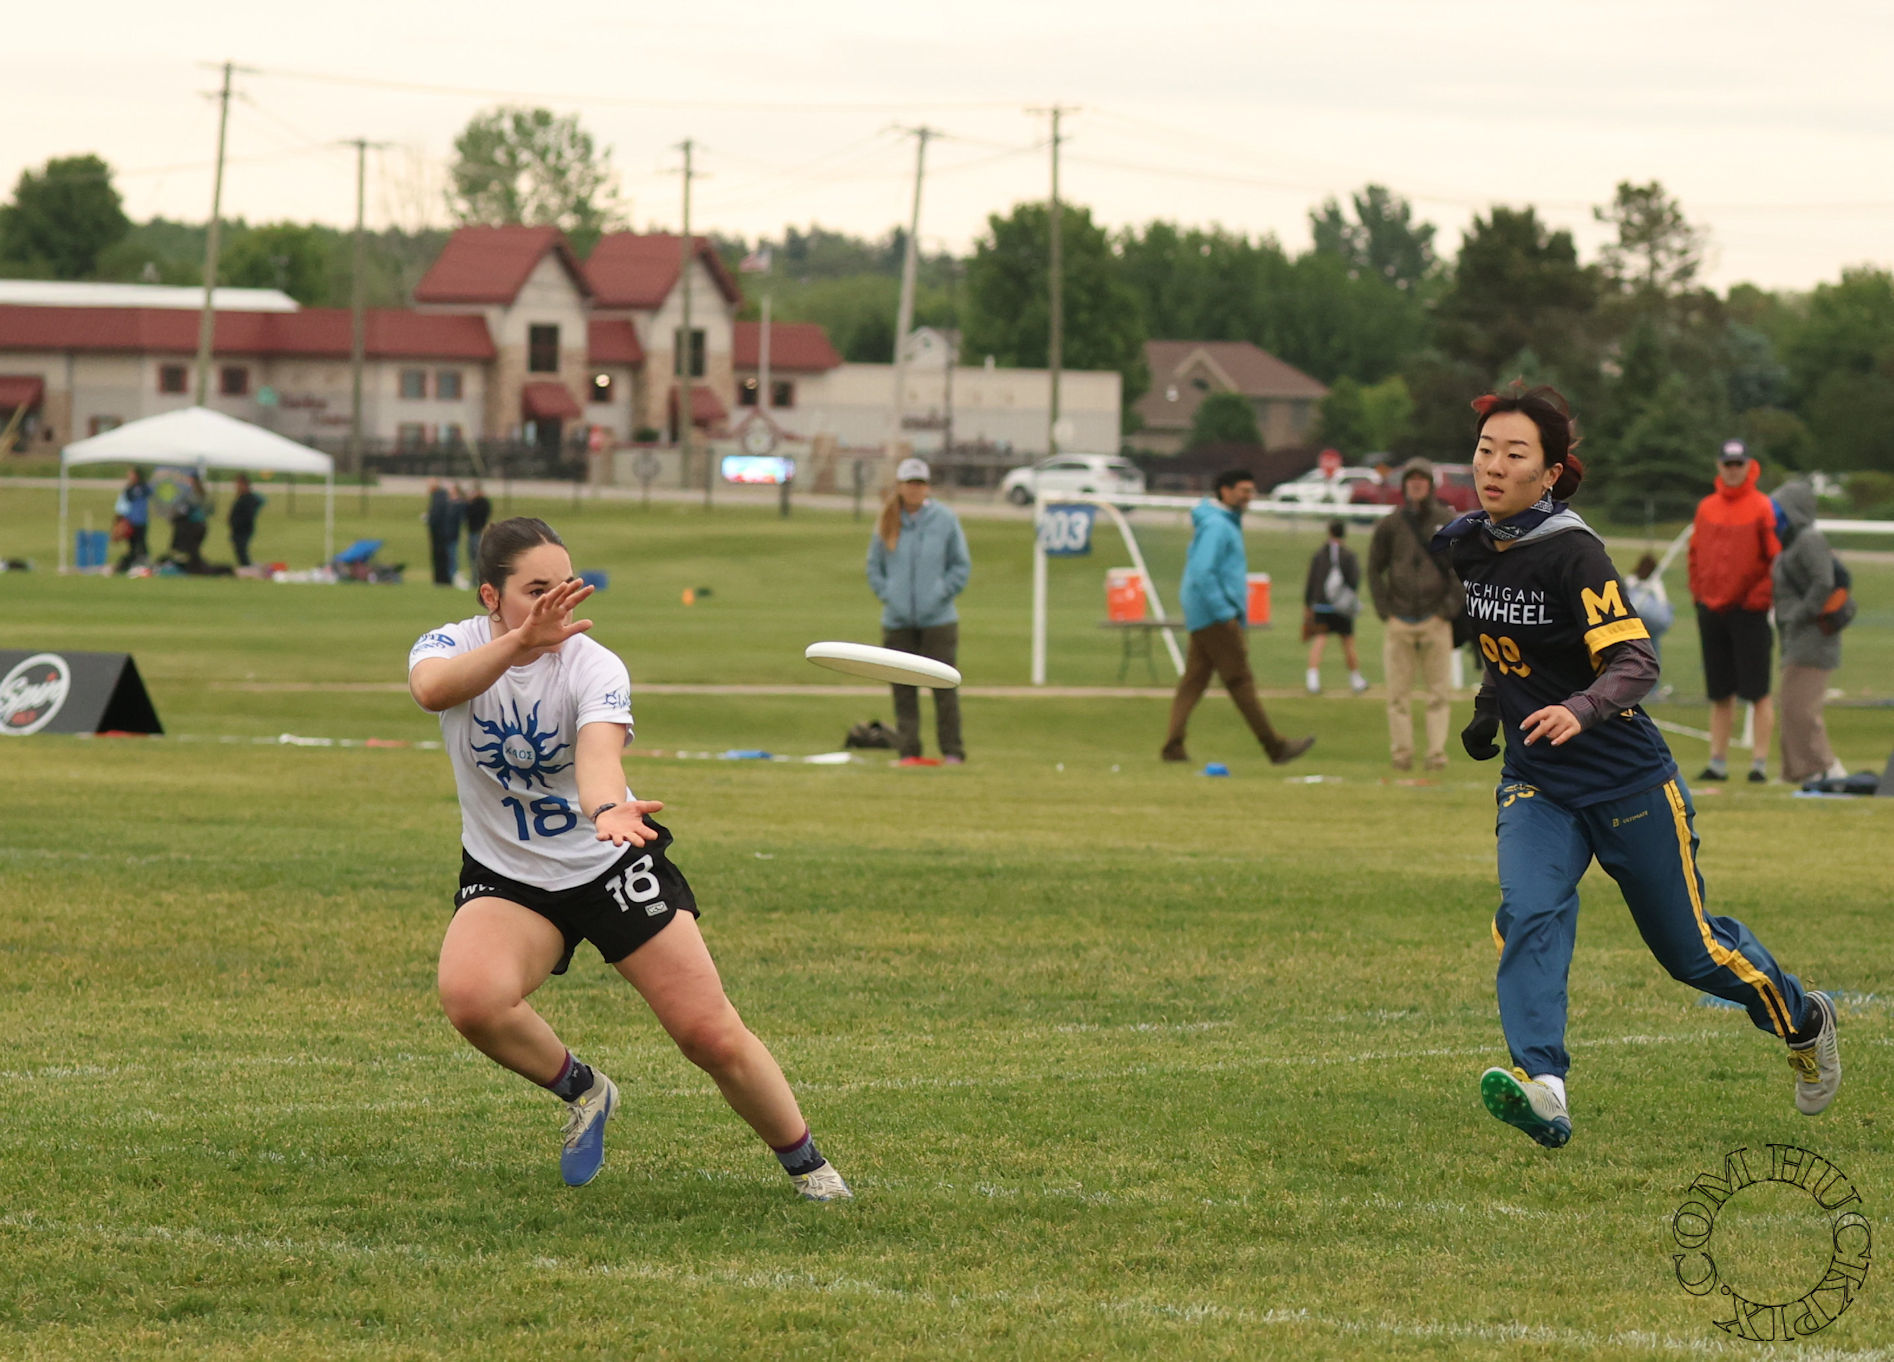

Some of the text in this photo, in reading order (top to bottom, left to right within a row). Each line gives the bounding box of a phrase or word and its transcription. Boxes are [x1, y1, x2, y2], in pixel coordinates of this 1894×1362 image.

[1465, 593, 1553, 625] LYWHEEL
[1581, 580, 1628, 626] M
[1479, 633, 1532, 678] 99
[501, 795, 577, 841] 18
[605, 854, 661, 913] 18
